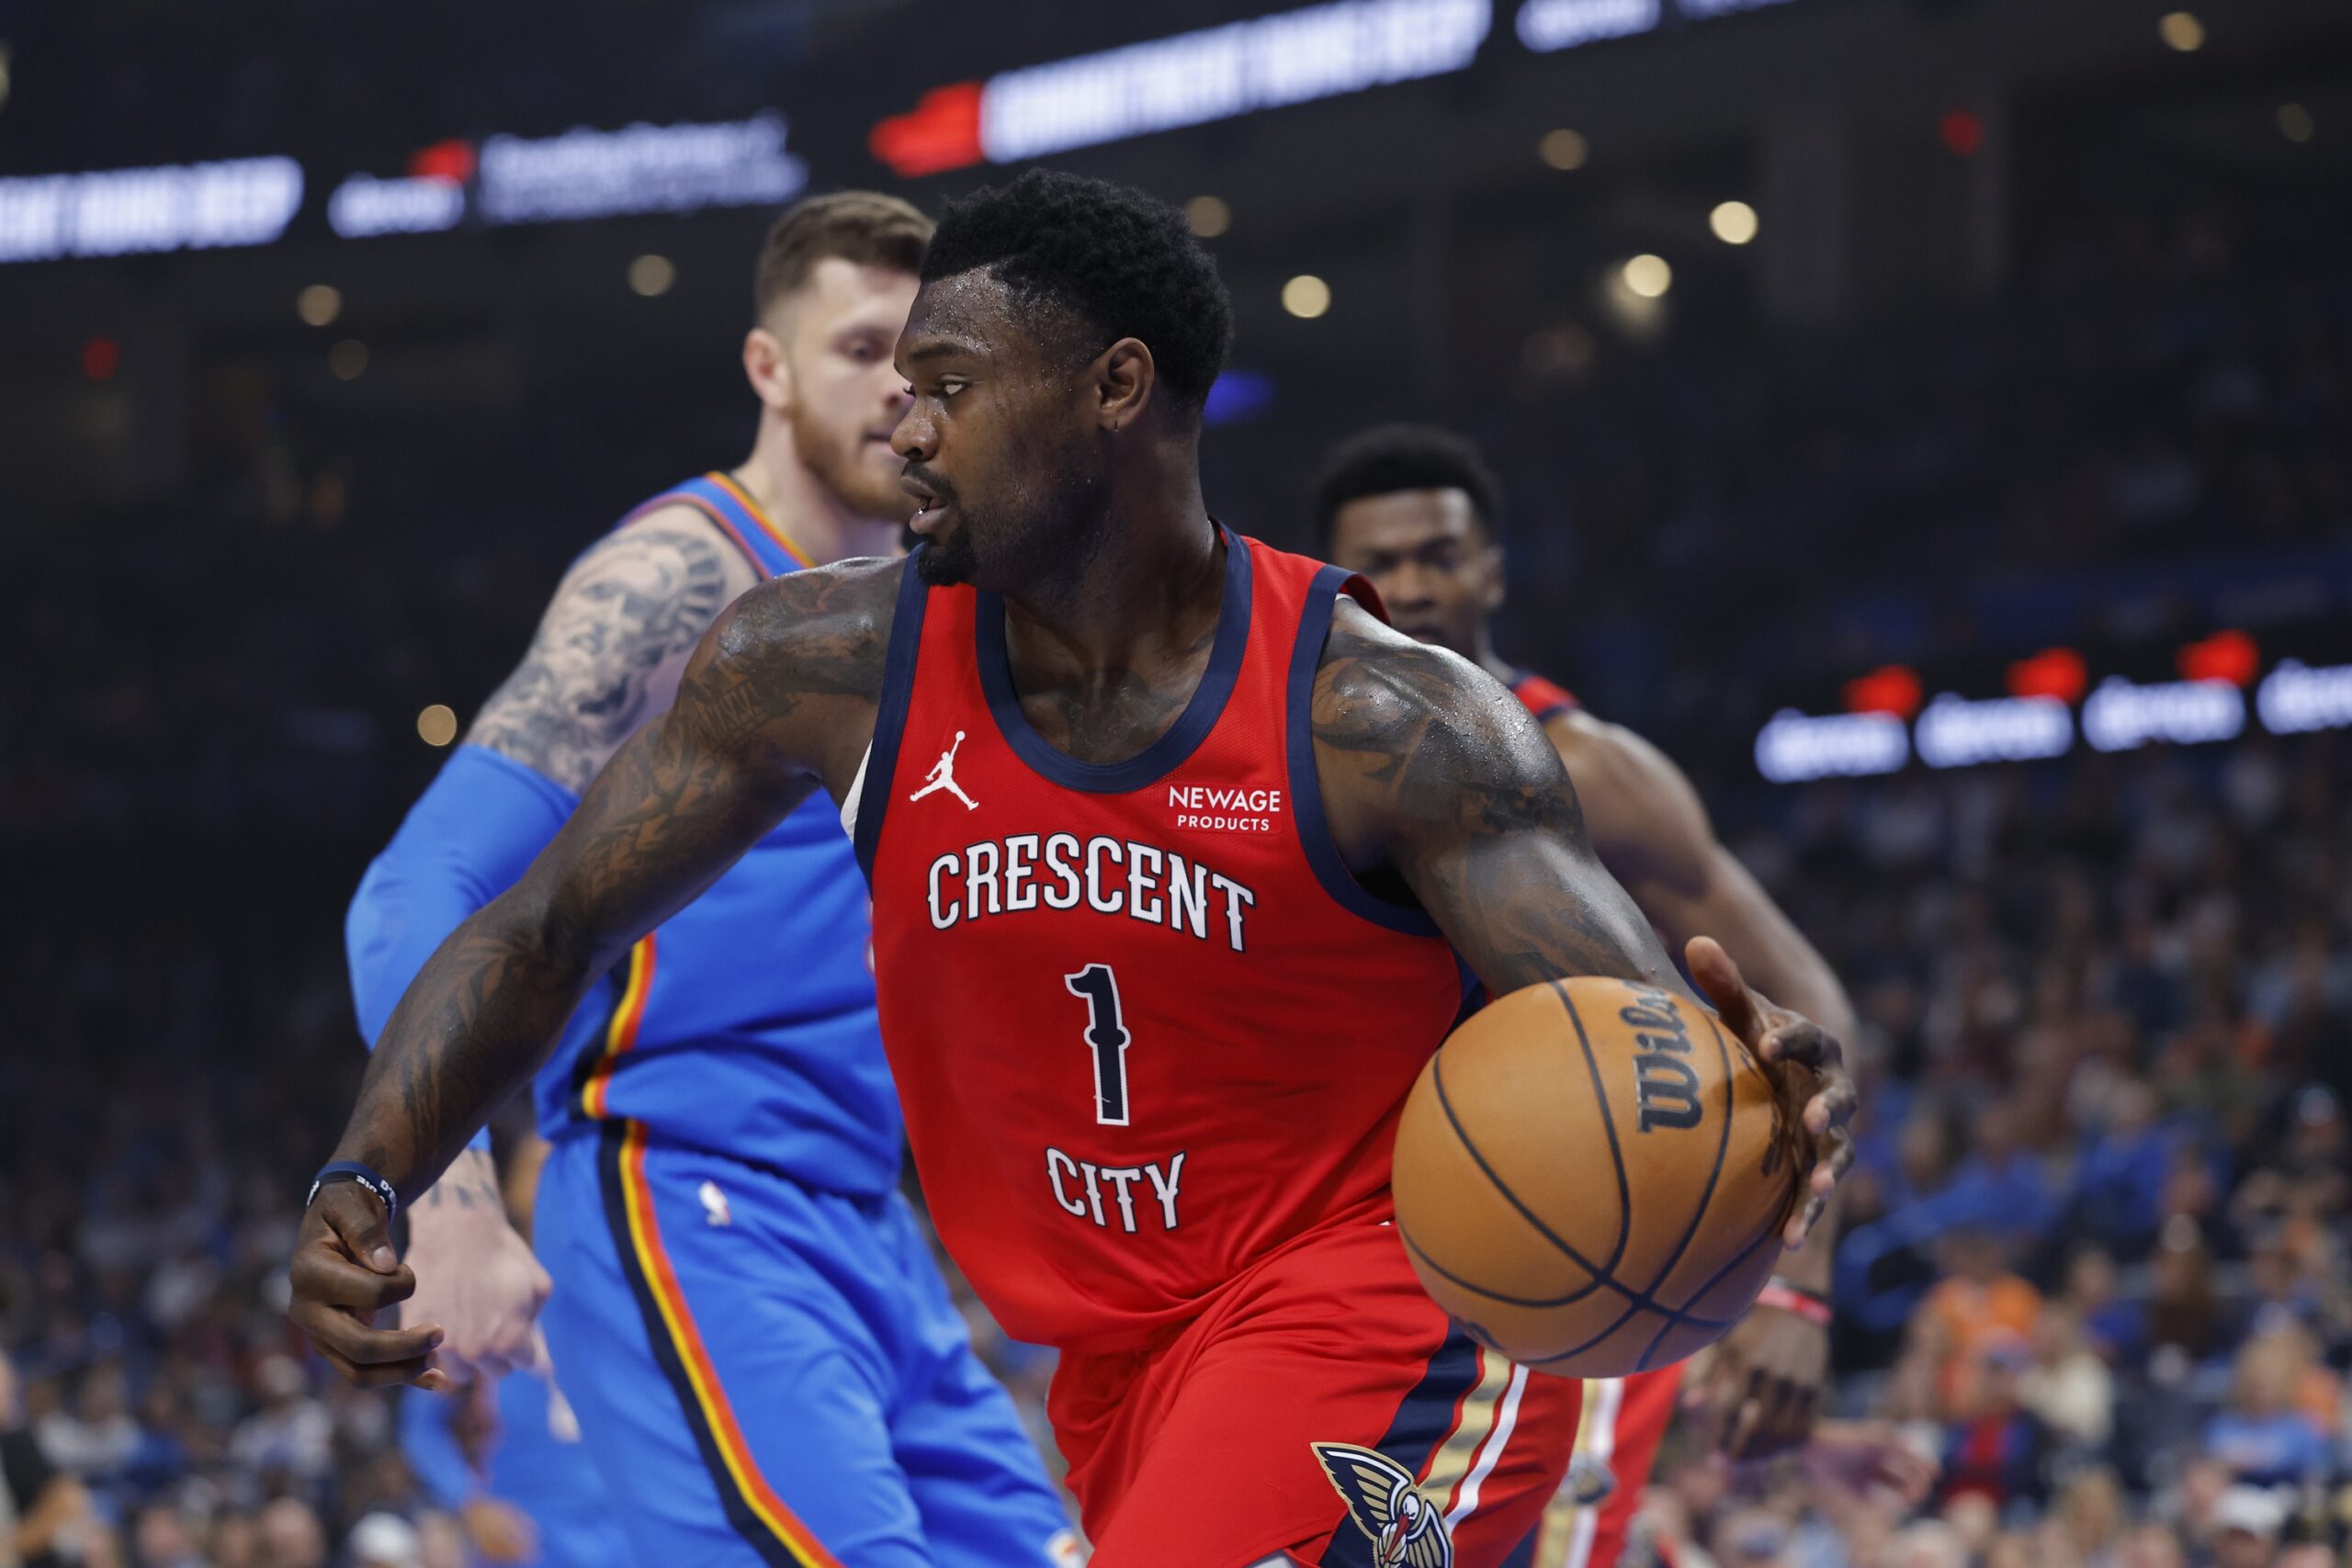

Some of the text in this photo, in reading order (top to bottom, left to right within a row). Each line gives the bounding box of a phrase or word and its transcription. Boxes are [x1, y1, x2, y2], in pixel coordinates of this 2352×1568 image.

[1169, 785, 1281, 813] NEWAGE
[1177, 814, 1270, 831] PRODUCTS
[927, 831, 1256, 953] CRESCENT
[1064, 963, 1131, 1126] 1
[1046, 1146, 1186, 1233] CITY
